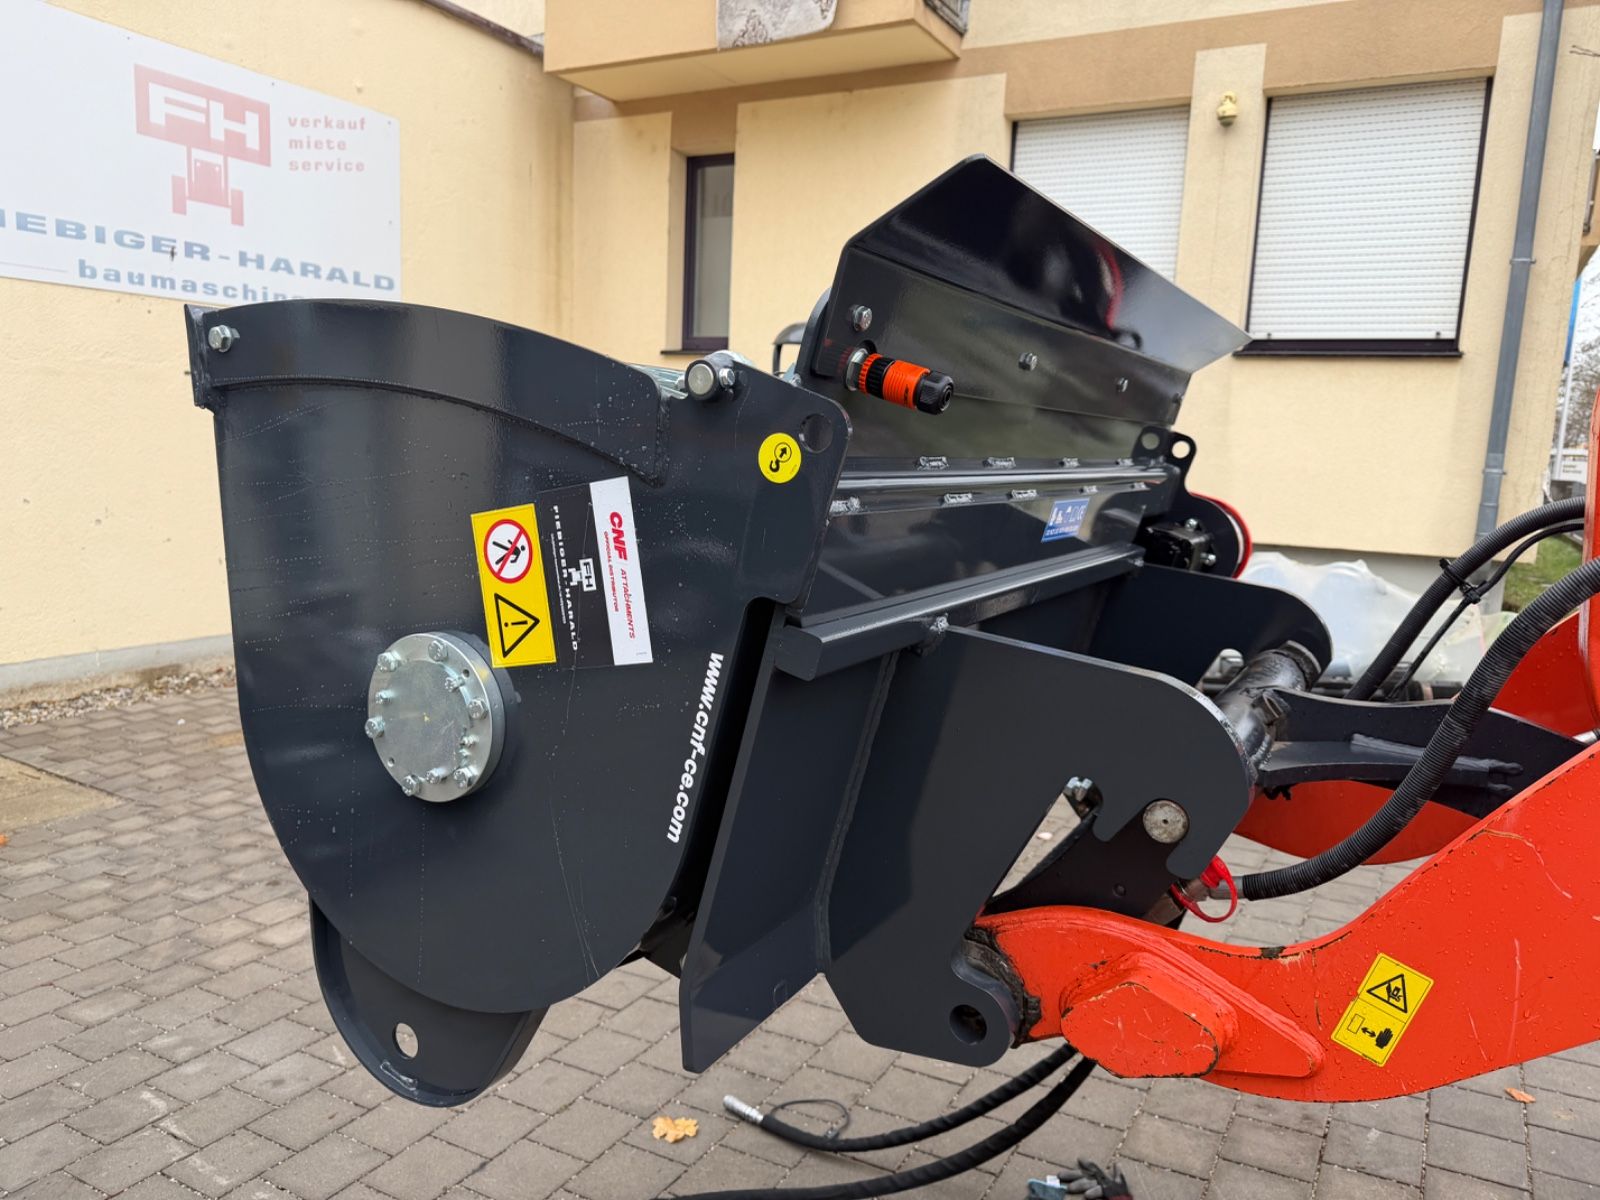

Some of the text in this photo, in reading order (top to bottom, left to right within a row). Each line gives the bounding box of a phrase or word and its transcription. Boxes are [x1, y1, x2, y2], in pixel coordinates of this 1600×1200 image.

[148, 82, 260, 151] FH
[288, 115, 366, 131] verkauf
[288, 137, 347, 151] miete
[288, 158, 365, 172] service
[78, 258, 305, 301] baumaschin
[583, 562, 594, 588] FH
[603, 531, 619, 612] OFFICIAL DISTRIBUTOR
[609, 511, 636, 640] CNF ATTACHMENTS
[667, 652, 724, 844] www.cnf-ce.com
